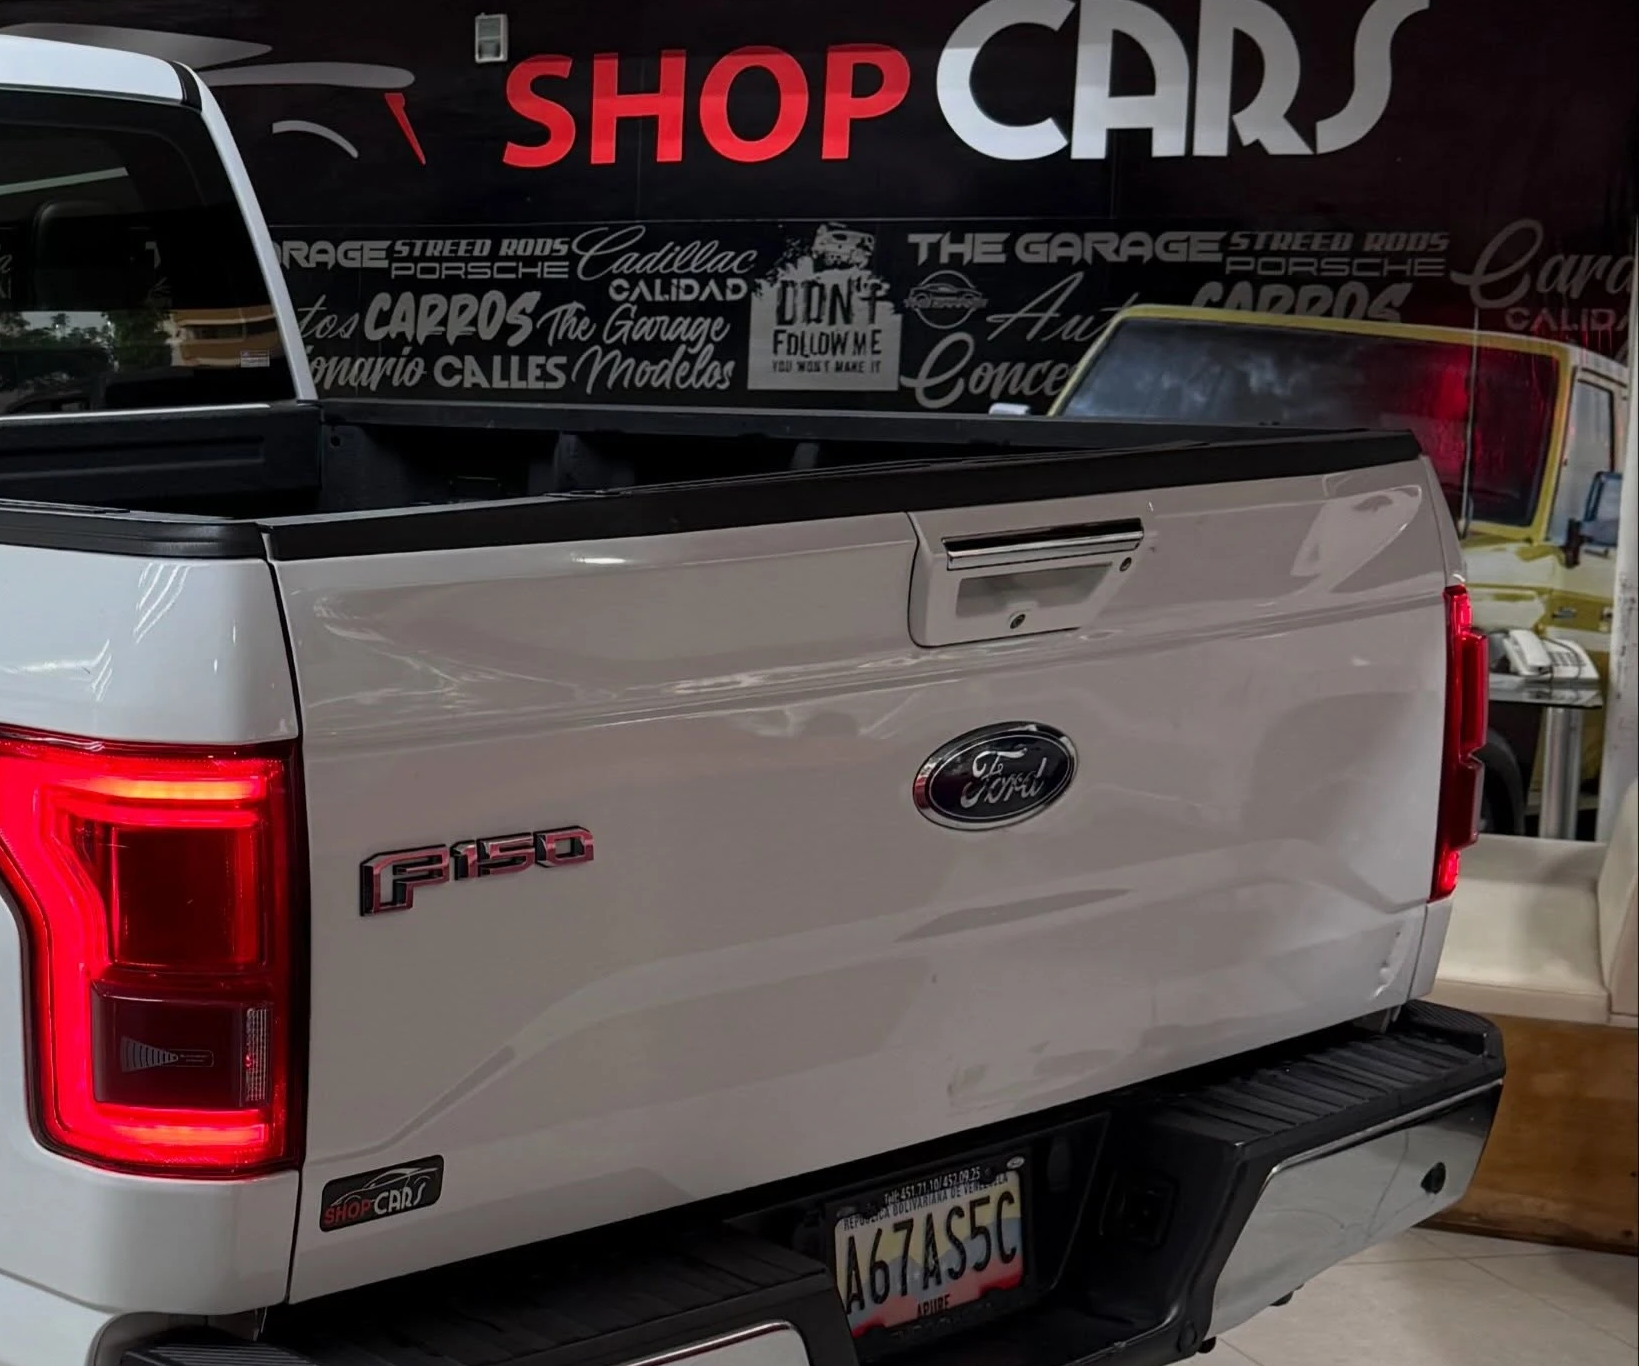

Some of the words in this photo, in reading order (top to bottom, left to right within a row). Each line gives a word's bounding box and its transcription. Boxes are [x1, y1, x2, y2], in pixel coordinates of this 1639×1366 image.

[503, 43, 910, 168] SHOP
[499, 238, 571, 257] RODS
[570, 223, 759, 282] Cadillac
[906, 230, 1012, 267] THE
[1014, 230, 1229, 267] GARAGE
[1362, 231, 1451, 252] RODS
[391, 261, 571, 280] PORSCHE
[1224, 256, 1447, 277] PORSCHE
[608, 278, 750, 303] CALIDAD
[364, 288, 543, 348] CARROS
[536, 299, 598, 348] The
[601, 302, 733, 355] Garage
[772, 329, 849, 357] FOLLOW
[853, 329, 883, 356] ME
[433, 354, 570, 390] CALLES
[570, 342, 737, 396] Modelos
[772, 360, 793, 373] YOU
[834, 360, 865, 373] MAKE
[869, 360, 882, 373] IT
[960, 747, 1048, 809] Ford
[964, 1172, 1009, 1196] VENELA
[324, 1198, 372, 1224] SHOP
[373, 1181, 427, 1215] CARS
[845, 1190, 1018, 1316] A67AS5C
